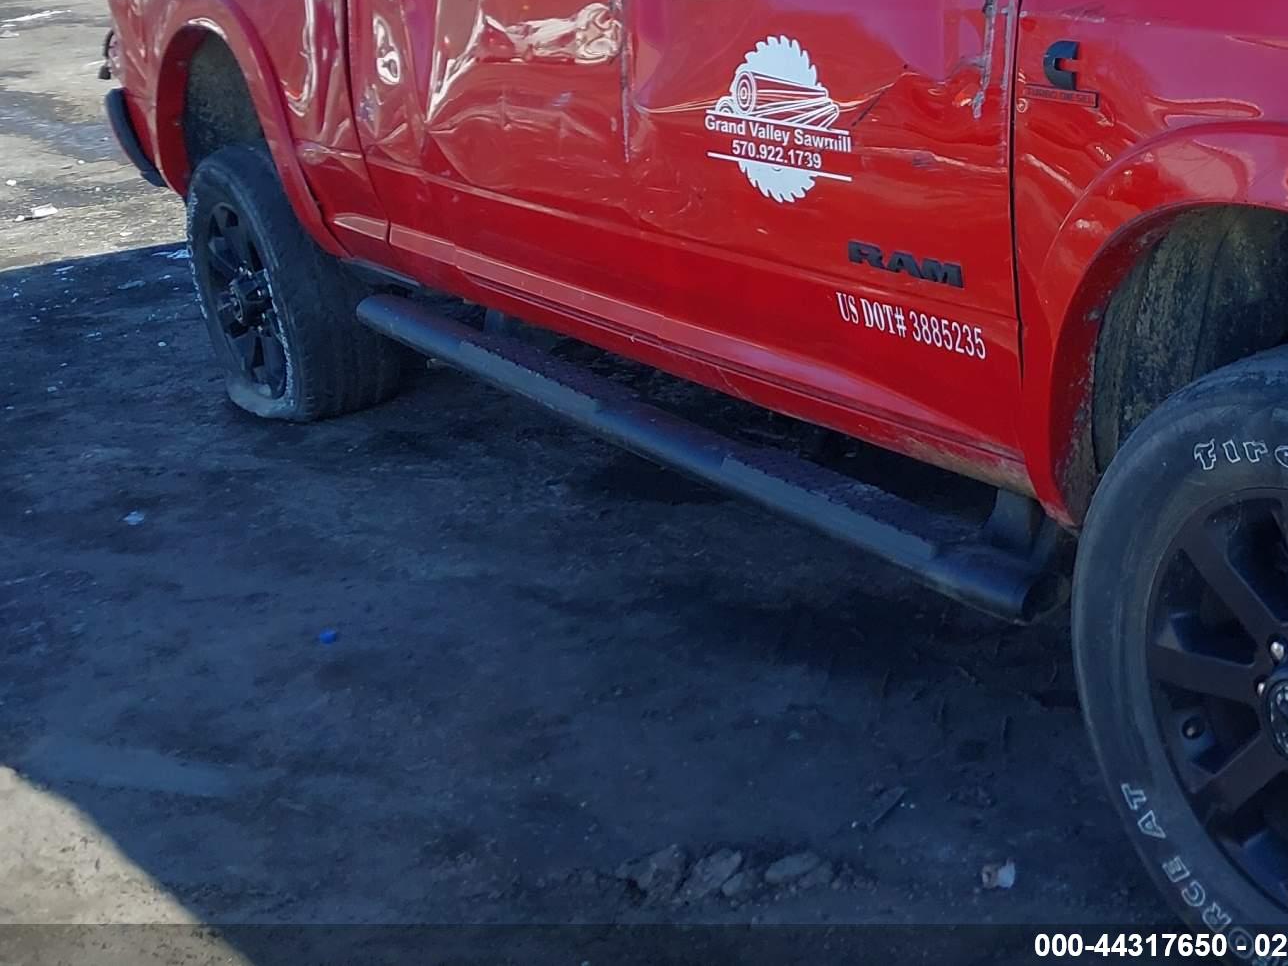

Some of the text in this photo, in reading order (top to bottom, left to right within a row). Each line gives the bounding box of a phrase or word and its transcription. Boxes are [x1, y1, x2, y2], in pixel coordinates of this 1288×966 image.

[704, 115, 852, 153] Grand Valley Sawmill
[732, 139, 822, 169] 570.922.1739
[848, 240, 964, 289] RAM
[836, 292, 986, 360] US DOT# 3885235
[1121, 783, 1167, 838] AT
